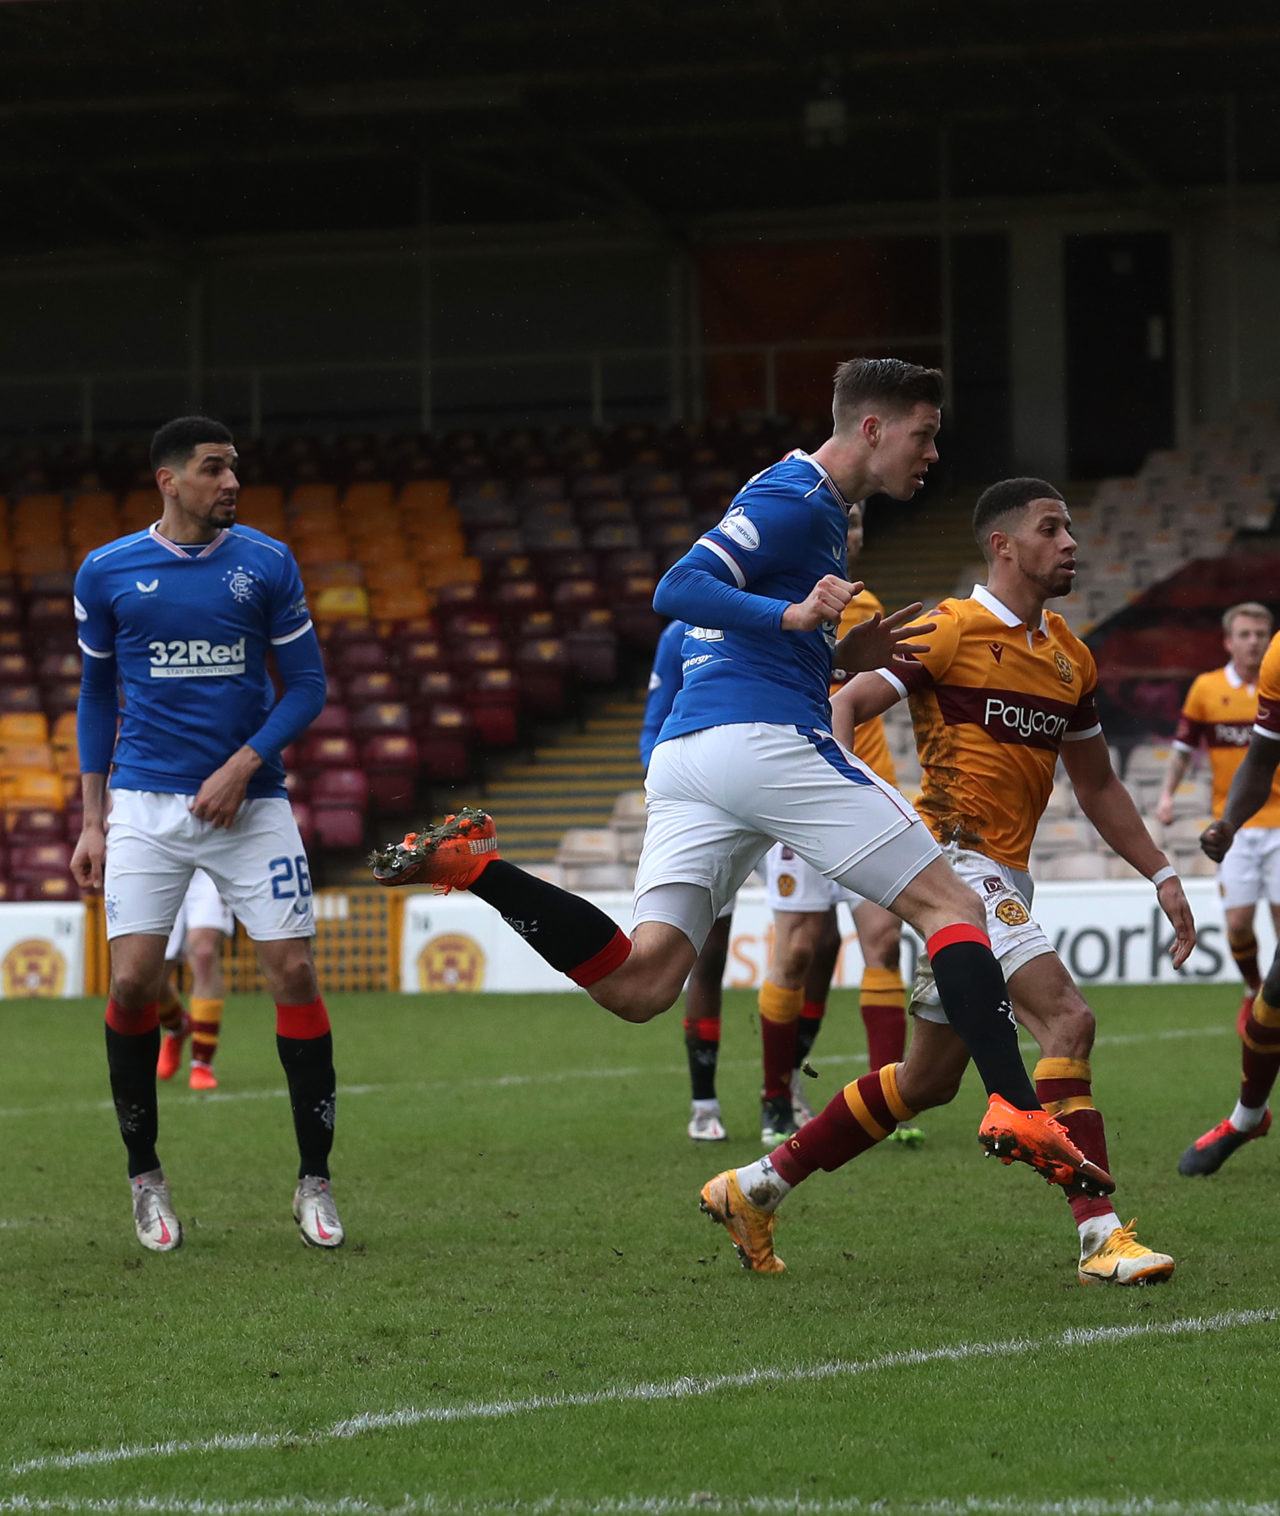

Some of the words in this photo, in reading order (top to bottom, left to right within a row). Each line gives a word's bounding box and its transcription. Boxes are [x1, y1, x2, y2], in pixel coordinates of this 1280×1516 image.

[149, 637, 245, 665] 32Red
[166, 668, 182, 676] STAY
[984, 698, 1068, 737] Paycar
[269, 855, 311, 899] 26
